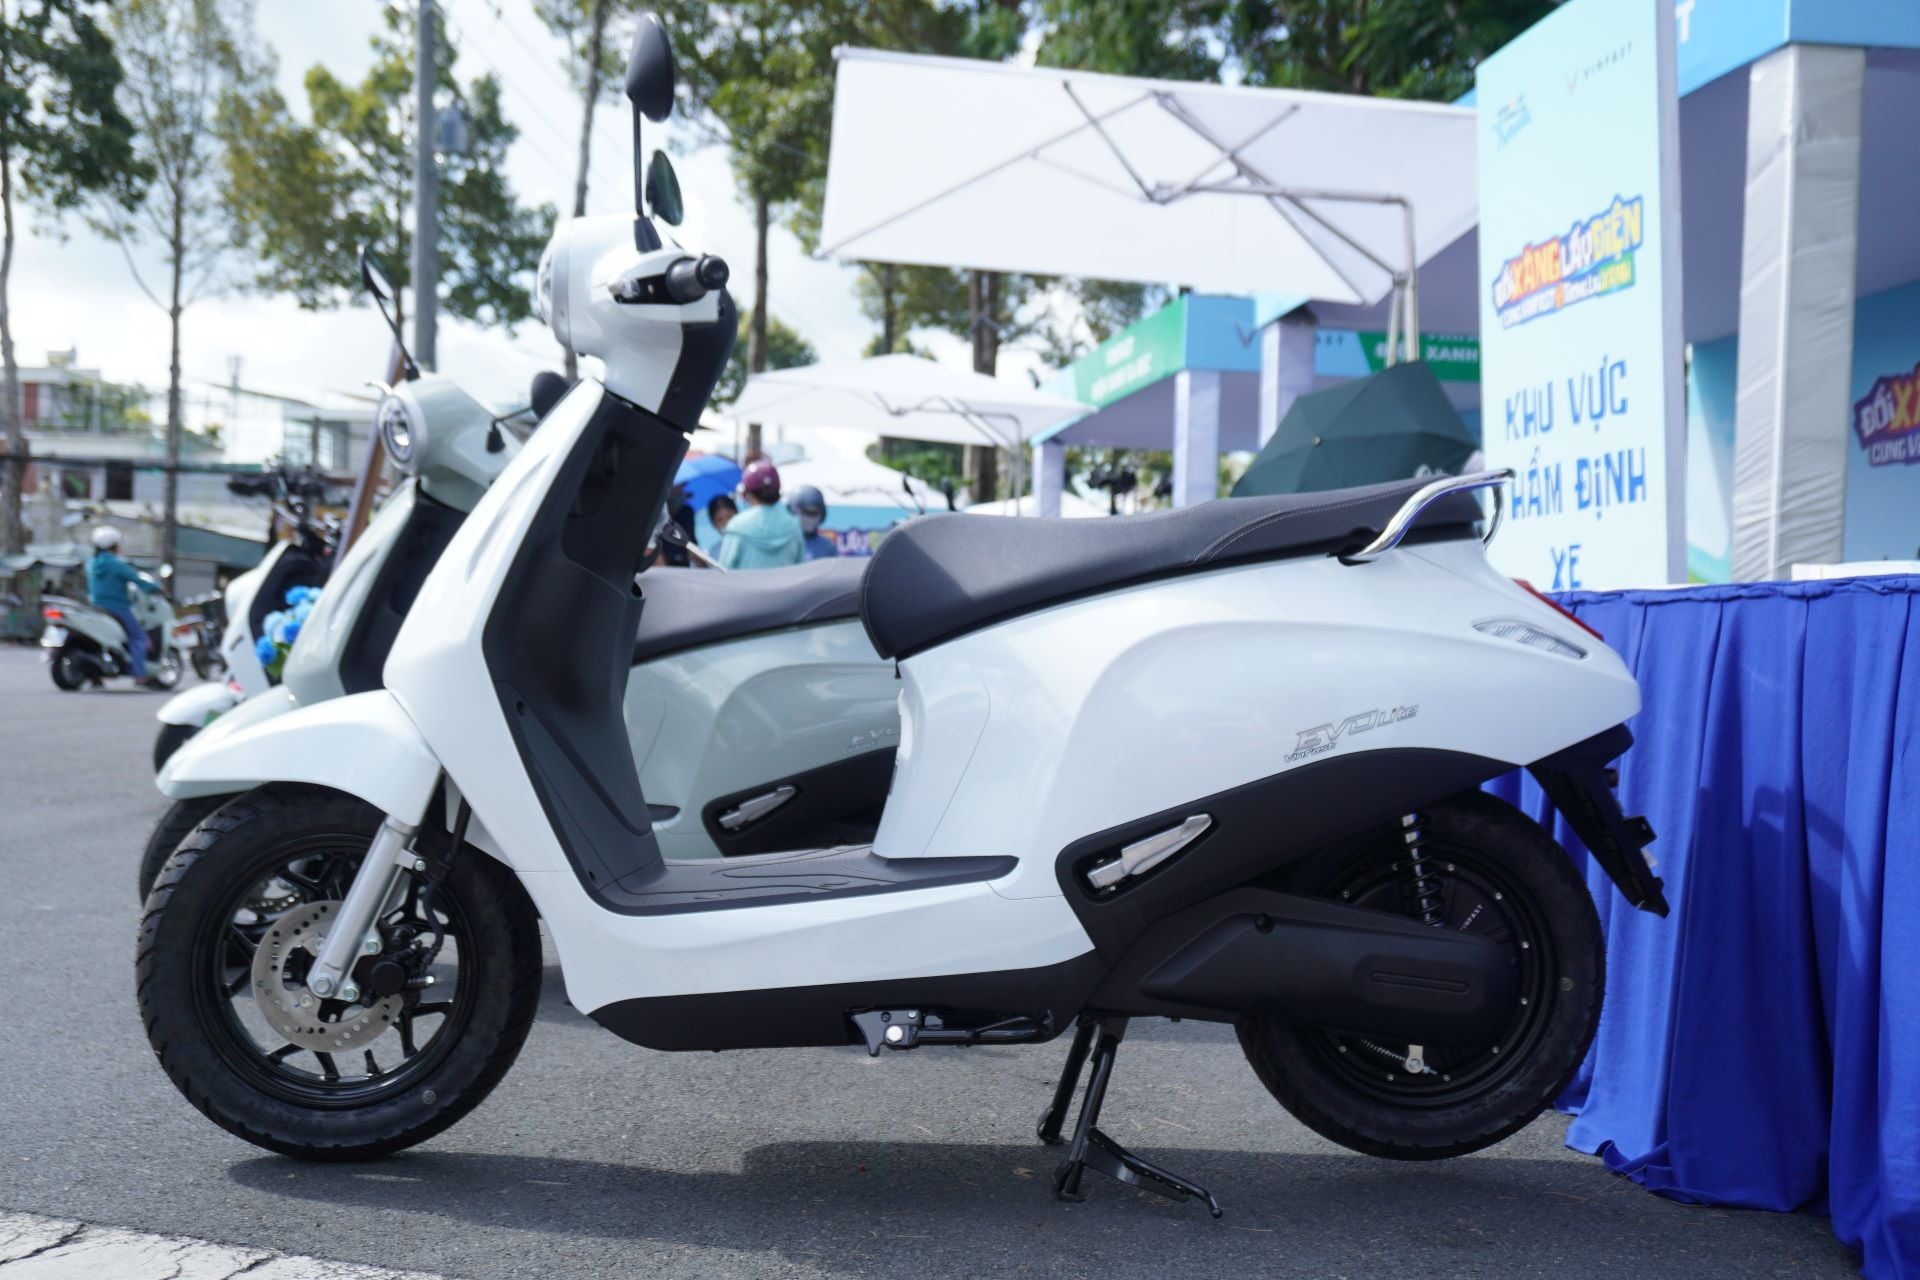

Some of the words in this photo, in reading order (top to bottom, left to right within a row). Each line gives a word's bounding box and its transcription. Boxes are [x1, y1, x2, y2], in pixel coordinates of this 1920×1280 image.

[1505, 381, 1554, 442] KHU
[1568, 354, 1628, 434] VỰC
[1510, 445, 1563, 521] HẨM
[1550, 544, 1582, 590] XE
